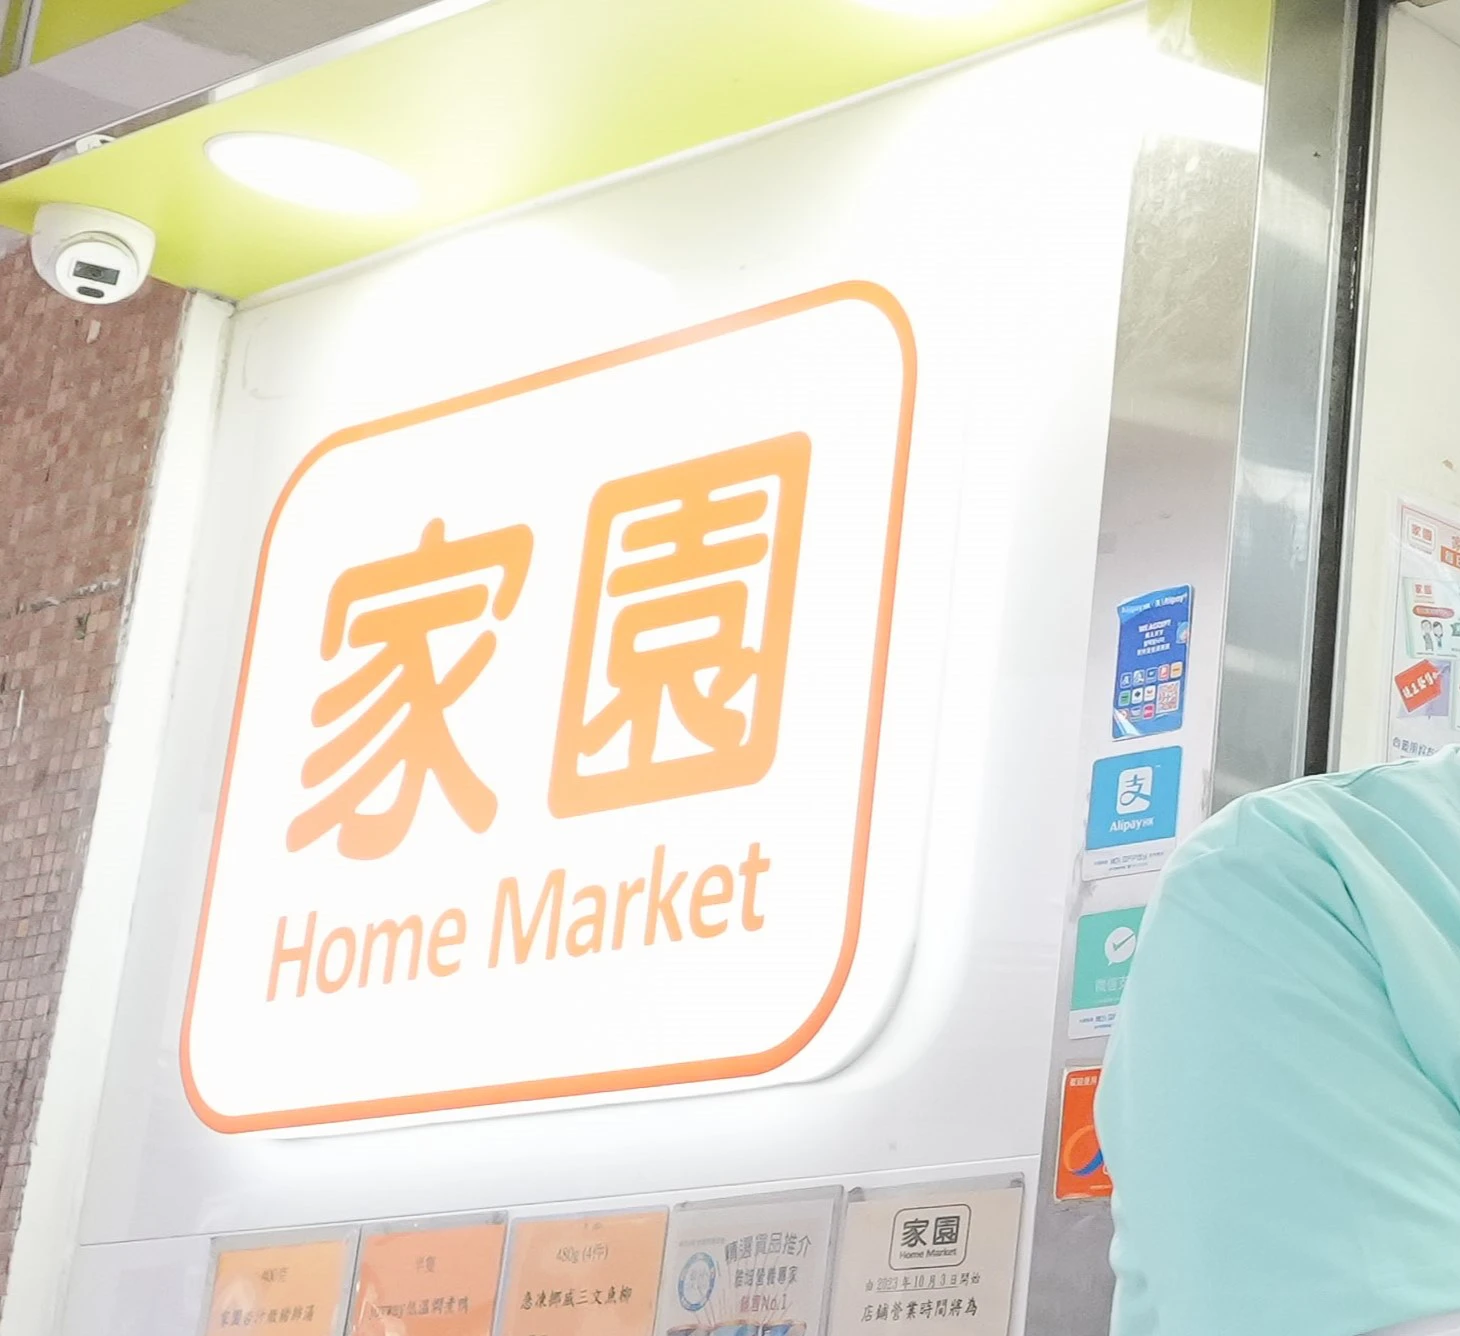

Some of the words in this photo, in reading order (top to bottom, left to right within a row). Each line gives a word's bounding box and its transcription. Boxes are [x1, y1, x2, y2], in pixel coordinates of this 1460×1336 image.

[286, 431, 812, 861] 家園
[1109, 816, 1154, 832] AlipayHK
[265, 905, 467, 1002] Home
[487, 842, 771, 968] Market
[901, 1215, 961, 1248] 家園
[927, 1247, 957, 1259] Market
